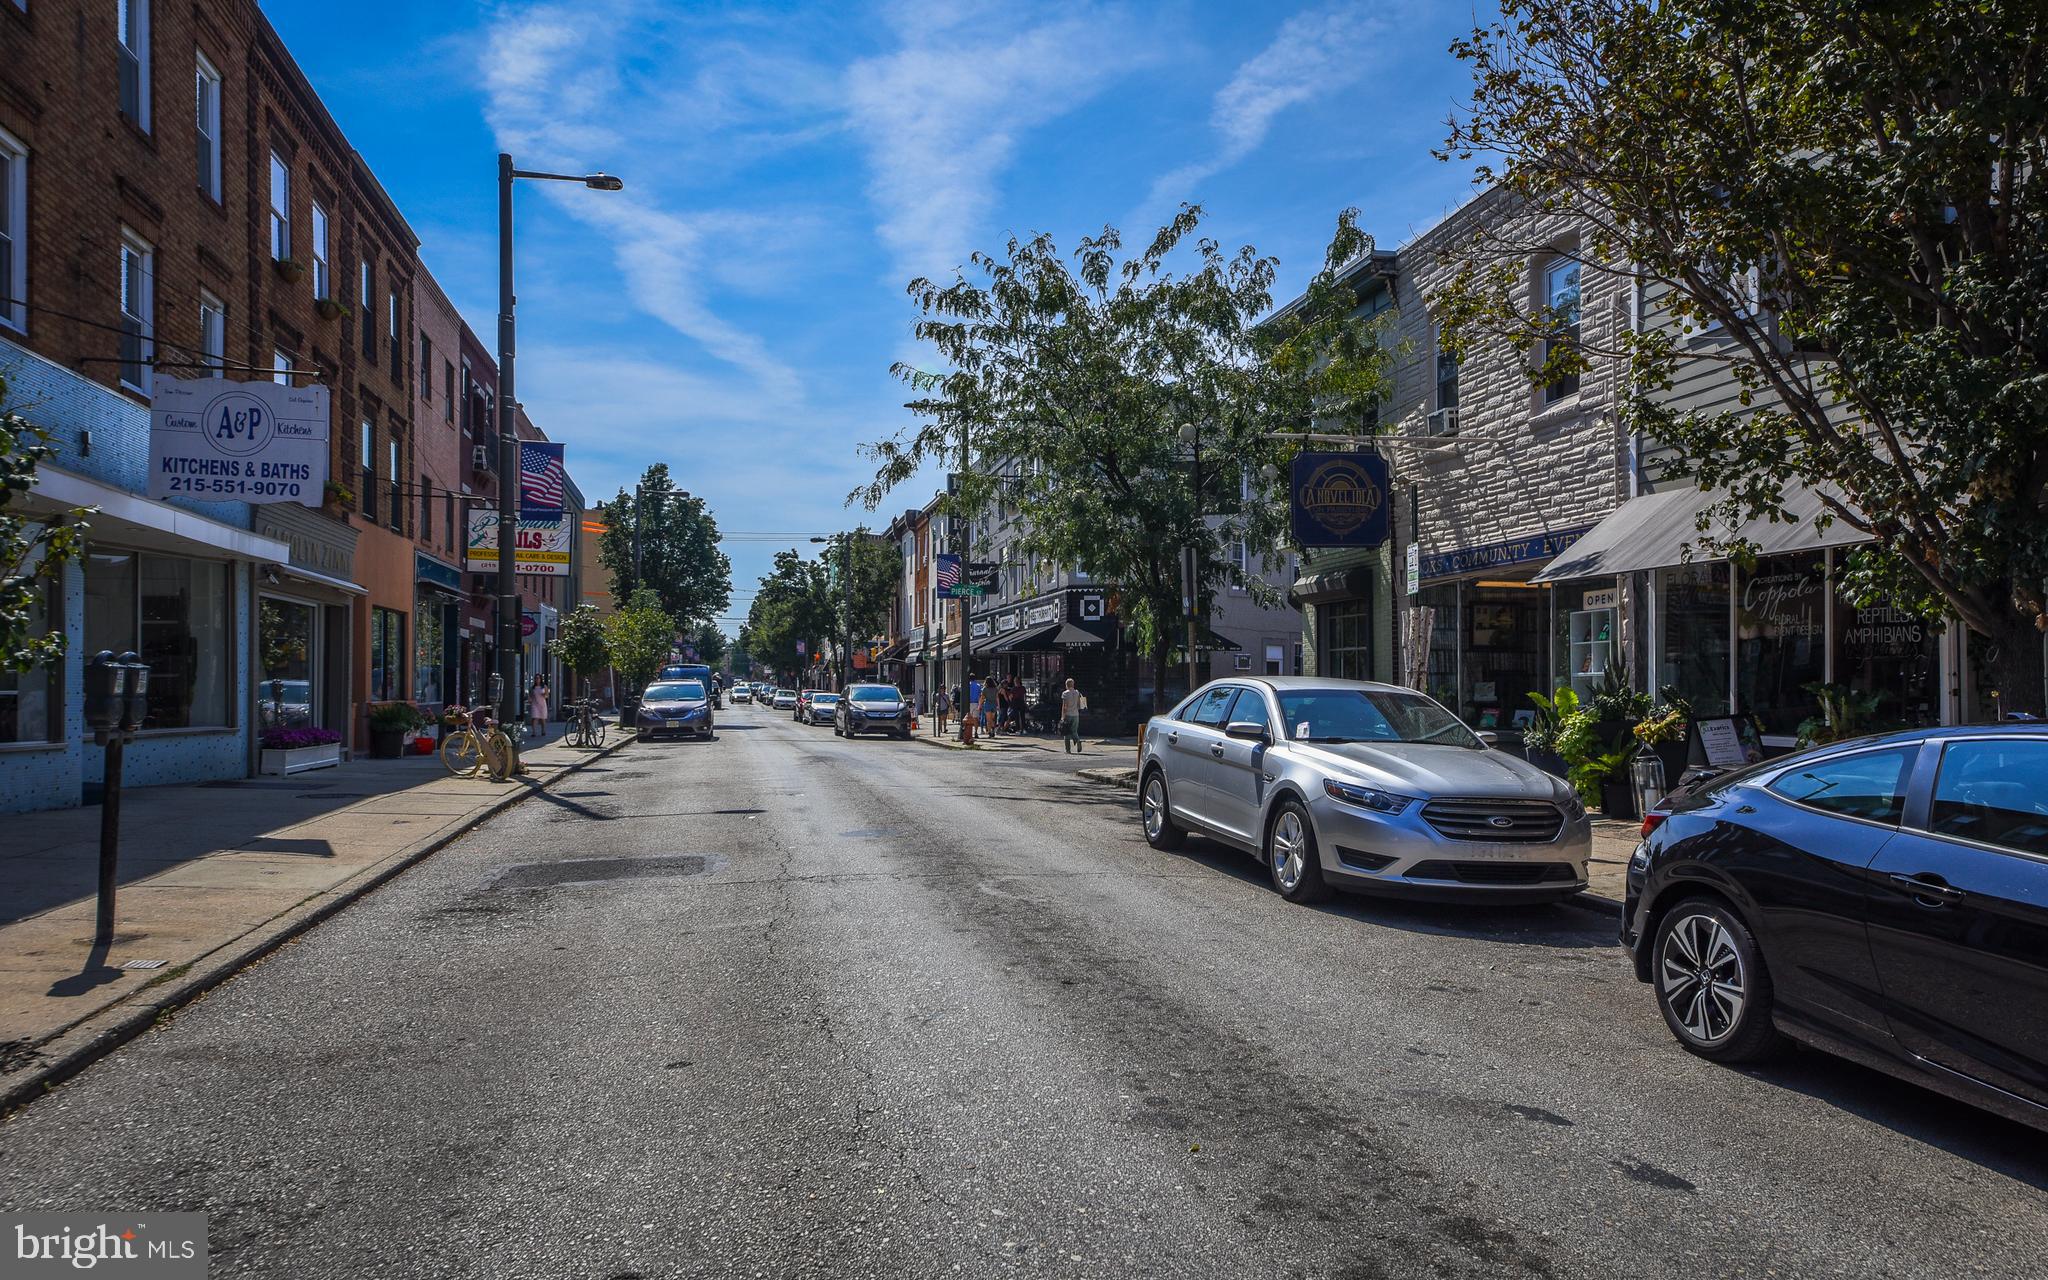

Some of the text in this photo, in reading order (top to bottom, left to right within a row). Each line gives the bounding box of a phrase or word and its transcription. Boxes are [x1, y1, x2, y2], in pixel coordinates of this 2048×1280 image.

[165, 414, 312, 436] Custom Kitchens
[216, 406, 261, 440] A&P
[162, 456, 309, 480] KITCHENS & BATHS
[169, 477, 300, 497] 215-551-9070
[1306, 488, 1376, 505] A NOVEL IDEA
[547, 553, 567, 561] DESIGN
[1452, 542, 1530, 569] COMMUNITY
[951, 587, 974, 595] PIERCE
[1587, 593, 1614, 606] OPEN
[1744, 576, 1822, 620] Coppola
[1774, 613, 1800, 625] FLORAL
[1857, 606, 1909, 624] REPTILES
[1844, 625, 1922, 645] AMPHIBIANS
